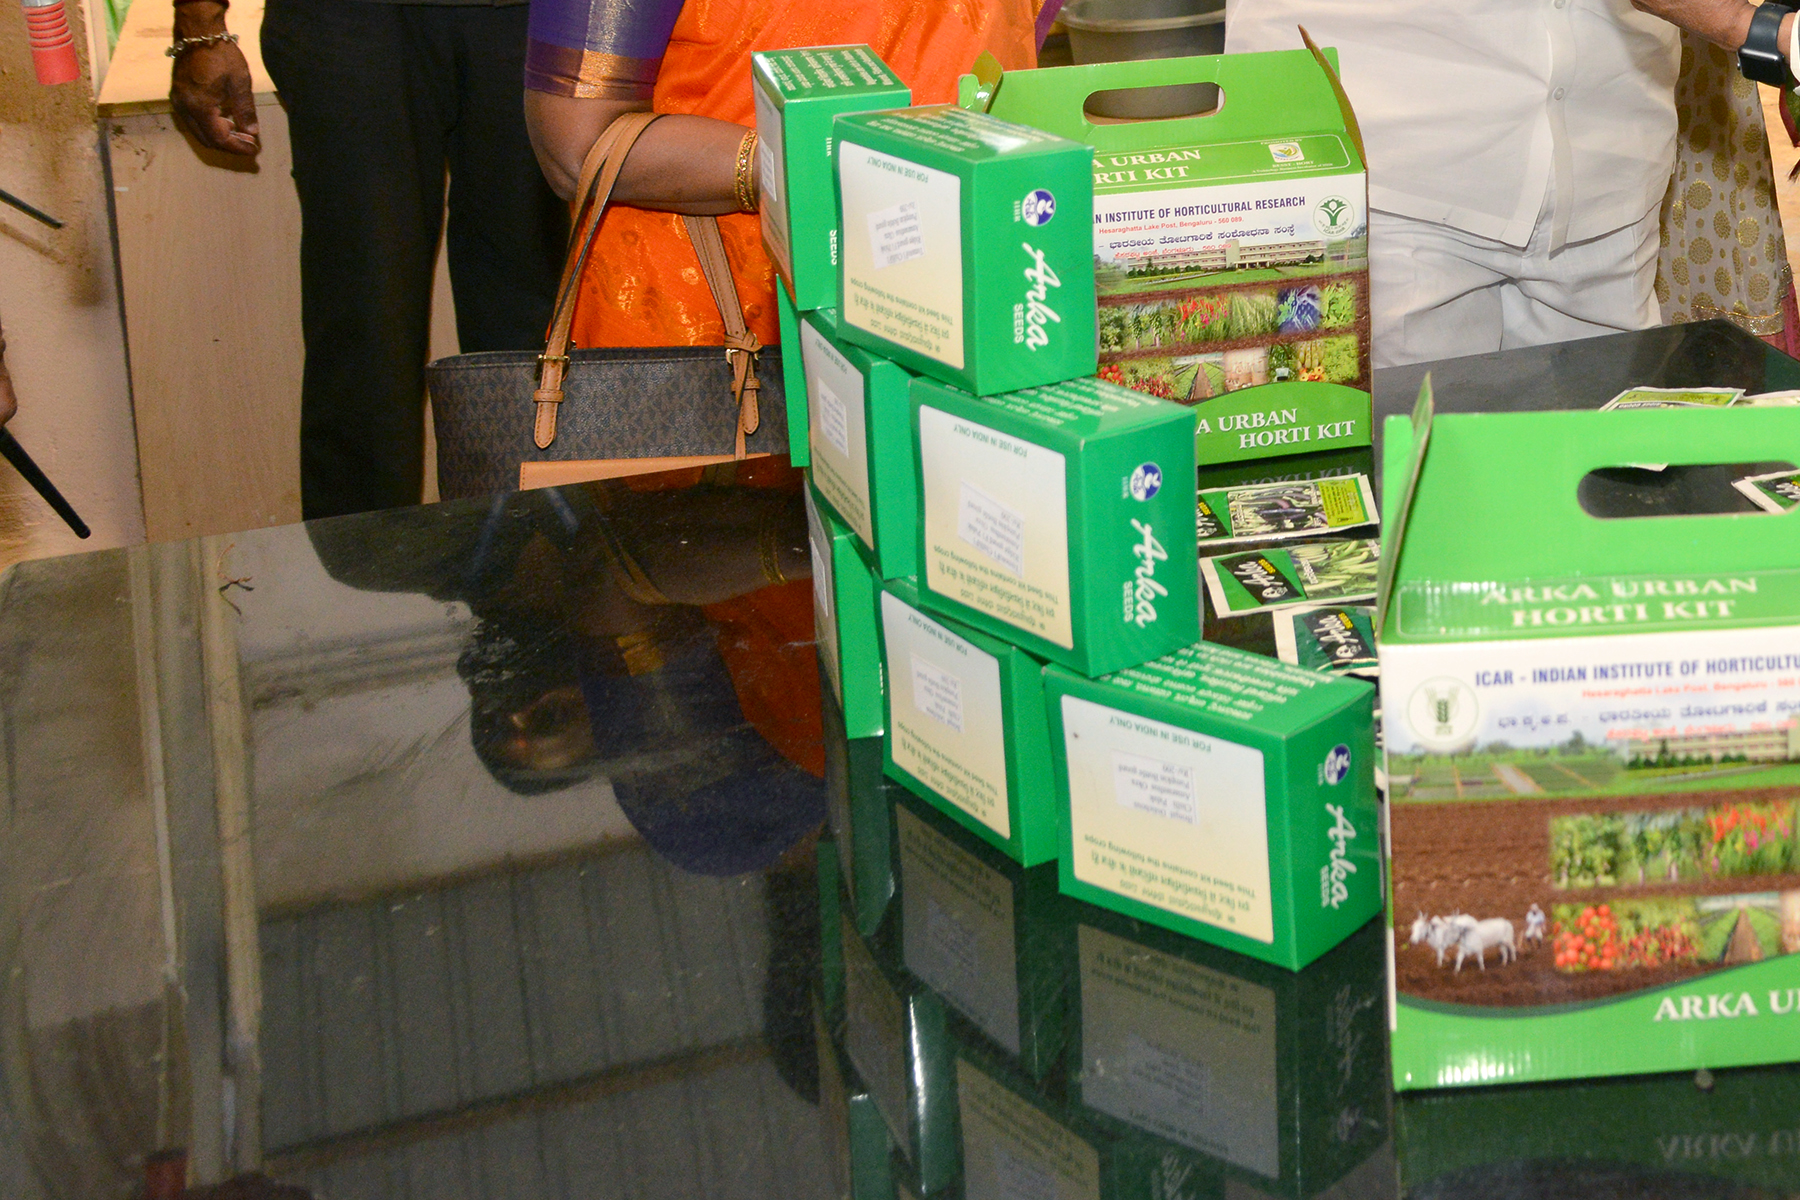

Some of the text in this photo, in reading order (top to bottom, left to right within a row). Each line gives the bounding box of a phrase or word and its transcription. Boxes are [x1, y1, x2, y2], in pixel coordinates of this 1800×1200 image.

[865, 155, 929, 183] FOR USE IN INDIA ONLY
[1110, 149, 1202, 167] URBAN
[1093, 165, 1190, 185] RTI KIT
[1013, 199, 1022, 223] IIHR
[1104, 208, 1155, 224] INSTITUTE
[1157, 207, 1172, 219] OF
[1173, 199, 1252, 218] HORTICULTURAL
[1254, 194, 1306, 211] RESEARCH
[1098, 223, 1143, 236] Hesaraghatta
[1143, 223, 1160, 231] Lake
[1160, 221, 1178, 230] Post,
[1178, 218, 1213, 229] Bengaluru
[1021, 242, 1062, 352] Arka
[1012, 303, 1024, 345] SEEDS
[1217, 407, 1299, 430] URBAN
[951, 422, 1029, 457] FOR USE IN INDIA ONLY
[1238, 422, 1315, 451] HORTI
[1317, 419, 1357, 440] KIT
[1130, 518, 1169, 629] Arka
[1258, 558, 1276, 574] SEEDS
[1122, 579, 1134, 624] SEEDS
[1479, 571, 1759, 608] ARKA URBAN
[1337, 612, 1354, 630] SEEDS
[1510, 596, 1738, 630] HORTI KIT
[1474, 668, 1515, 687] ICAR
[1531, 664, 1588, 684] INDIAN
[1591, 659, 1676, 681] INSTITUTE
[1679, 658, 1701, 676] OF
[1107, 714, 1213, 752] FOR USE IN INDIA ONLY
[1082, 833, 1257, 898] This Seed kit contains the following crops
[1323, 802, 1358, 910] Arka
[1319, 865, 1329, 909] SEEDS
[1652, 991, 1761, 1022] ARKA
